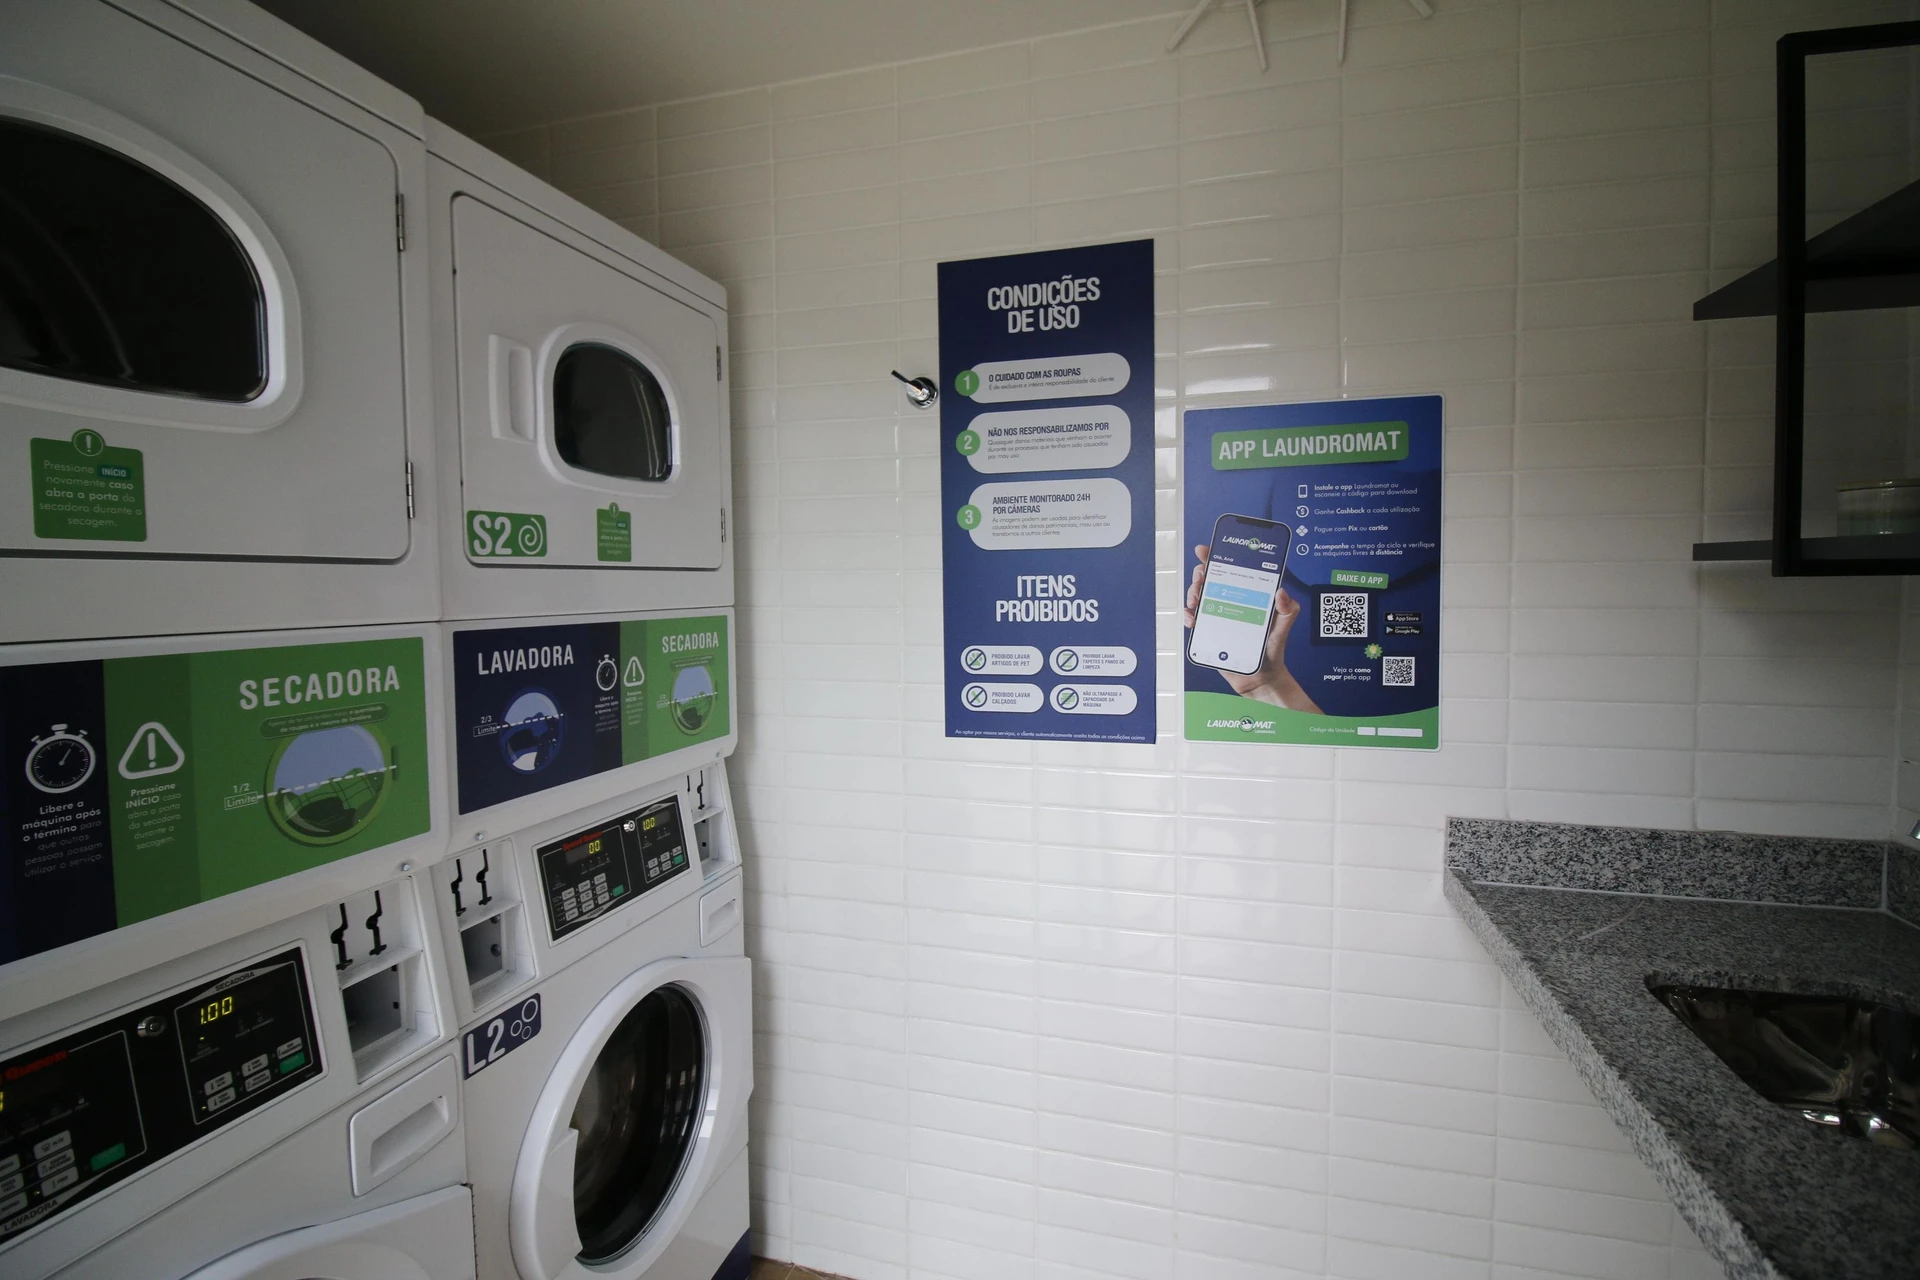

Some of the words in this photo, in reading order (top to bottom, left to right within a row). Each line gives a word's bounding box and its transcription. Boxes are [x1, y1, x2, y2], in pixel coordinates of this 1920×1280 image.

[988, 274, 1100, 310] CONDIÇÕES
[1008, 310, 1034, 333] DE
[1039, 304, 1080, 331] USO
[963, 375, 970, 389] 1
[995, 372, 1024, 381] CUIDADO
[1026, 371, 1041, 380] COM
[1054, 368, 1081, 377] ROUPAS
[988, 428, 1002, 436] NÃO
[1004, 428, 1018, 436] NOS
[1019, 423, 1093, 435] RESPONSABILIZAMOS
[1095, 422, 1109, 430] POR
[964, 435, 972, 449] 2
[1219, 440, 1256, 460] APP
[1262, 431, 1401, 458] LAUNDROMAT
[44, 460, 94, 473] Pressione
[102, 467, 126, 477] INÍCIO
[46, 476, 105, 487] novamente
[46, 488, 73, 497] abra
[89, 493, 118, 501] porta
[122, 493, 135, 502] da
[993, 495, 1028, 504] AMBIENTE
[1030, 494, 1075, 503] MONITORADO
[40, 503, 89, 512] secadora
[93, 504, 132, 515] durante
[993, 506, 1006, 514] POR
[1008, 505, 1040, 513] CÂMERAS
[68, 518, 118, 527] secagem.
[965, 510, 973, 524] 3
[473, 514, 512, 555] S2
[1017, 575, 1076, 597] ITENS
[1336, 574, 1359, 582] BAIXE
[1368, 576, 1383, 584] APP
[996, 599, 1099, 622] PROIBIDOS
[662, 632, 719, 653] SECADORA
[478, 644, 574, 675] LAVADORA
[239, 665, 400, 710] SECADORA
[481, 715, 492, 723] 2/3
[478, 726, 496, 735] Limite
[131, 783, 176, 796] Pressione
[233, 783, 250, 793] 1/2
[126, 795, 159, 808] INÍCIO
[163, 793, 181, 802] caso
[226, 795, 257, 808] Limite
[40, 803, 74, 814] Libere
[128, 809, 148, 819] abra
[159, 804, 180, 814] porta
[22, 815, 72, 830] máquina
[75, 808, 101, 819] após
[129, 822, 140, 830] da
[143, 814, 180, 827] secadora
[34, 825, 77, 839] término
[80, 820, 101, 831] para
[134, 827, 166, 840] durante
[38, 842, 56, 851] que
[60, 834, 89, 845] outras
[137, 836, 175, 850] secagem.
[25, 852, 64, 866] pessoas
[67, 842, 102, 856] possam
[25, 864, 56, 877] utilizar
[69, 854, 104, 867] serviço.
[215, 972, 255, 991] SECADORA
[200, 996, 232, 1025] 1.00
[467, 1018, 505, 1074] L2
[4, 1200, 58, 1232] LAVADORA
